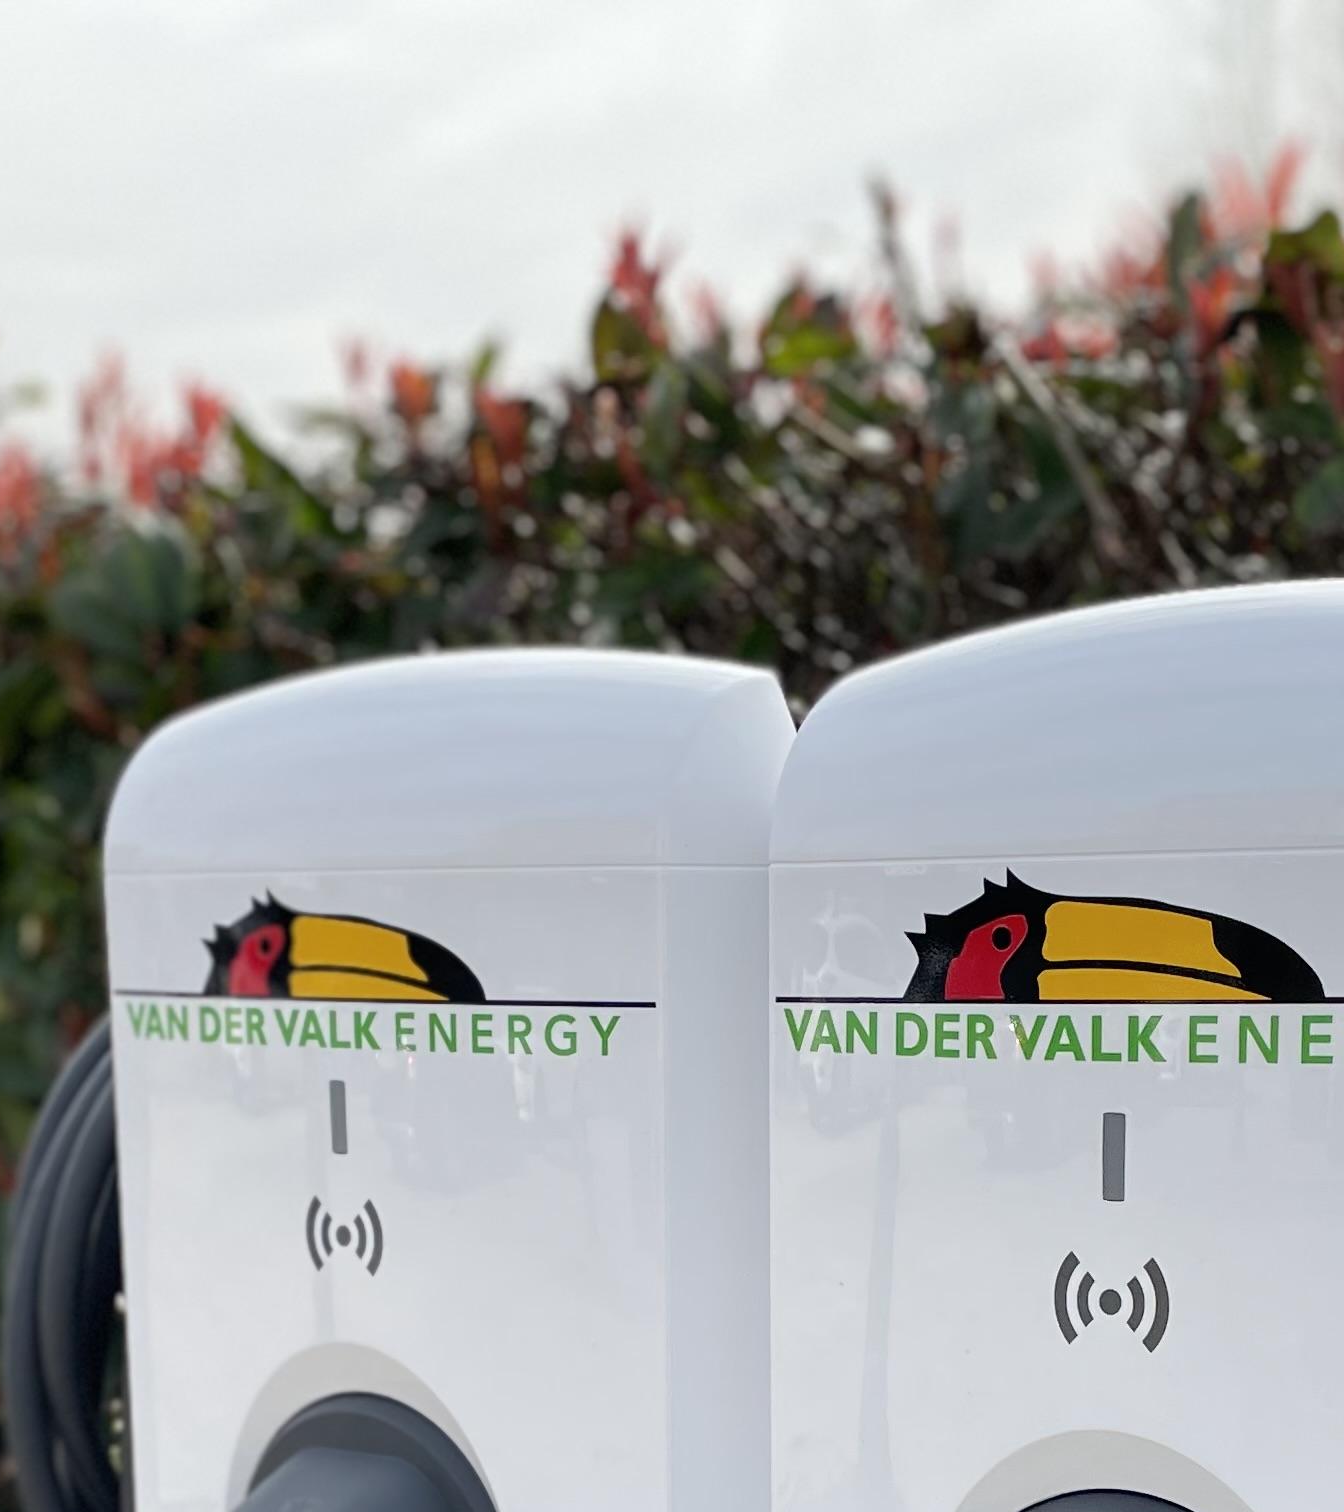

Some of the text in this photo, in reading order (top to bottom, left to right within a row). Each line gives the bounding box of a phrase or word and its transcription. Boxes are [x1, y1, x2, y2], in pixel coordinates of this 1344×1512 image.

[125, 1002, 621, 1056] VAN DER VALK ENERGY
[784, 1008, 878, 1054] VAN
[894, 1011, 998, 1060] DER
[1009, 1013, 1168, 1063] VALK
